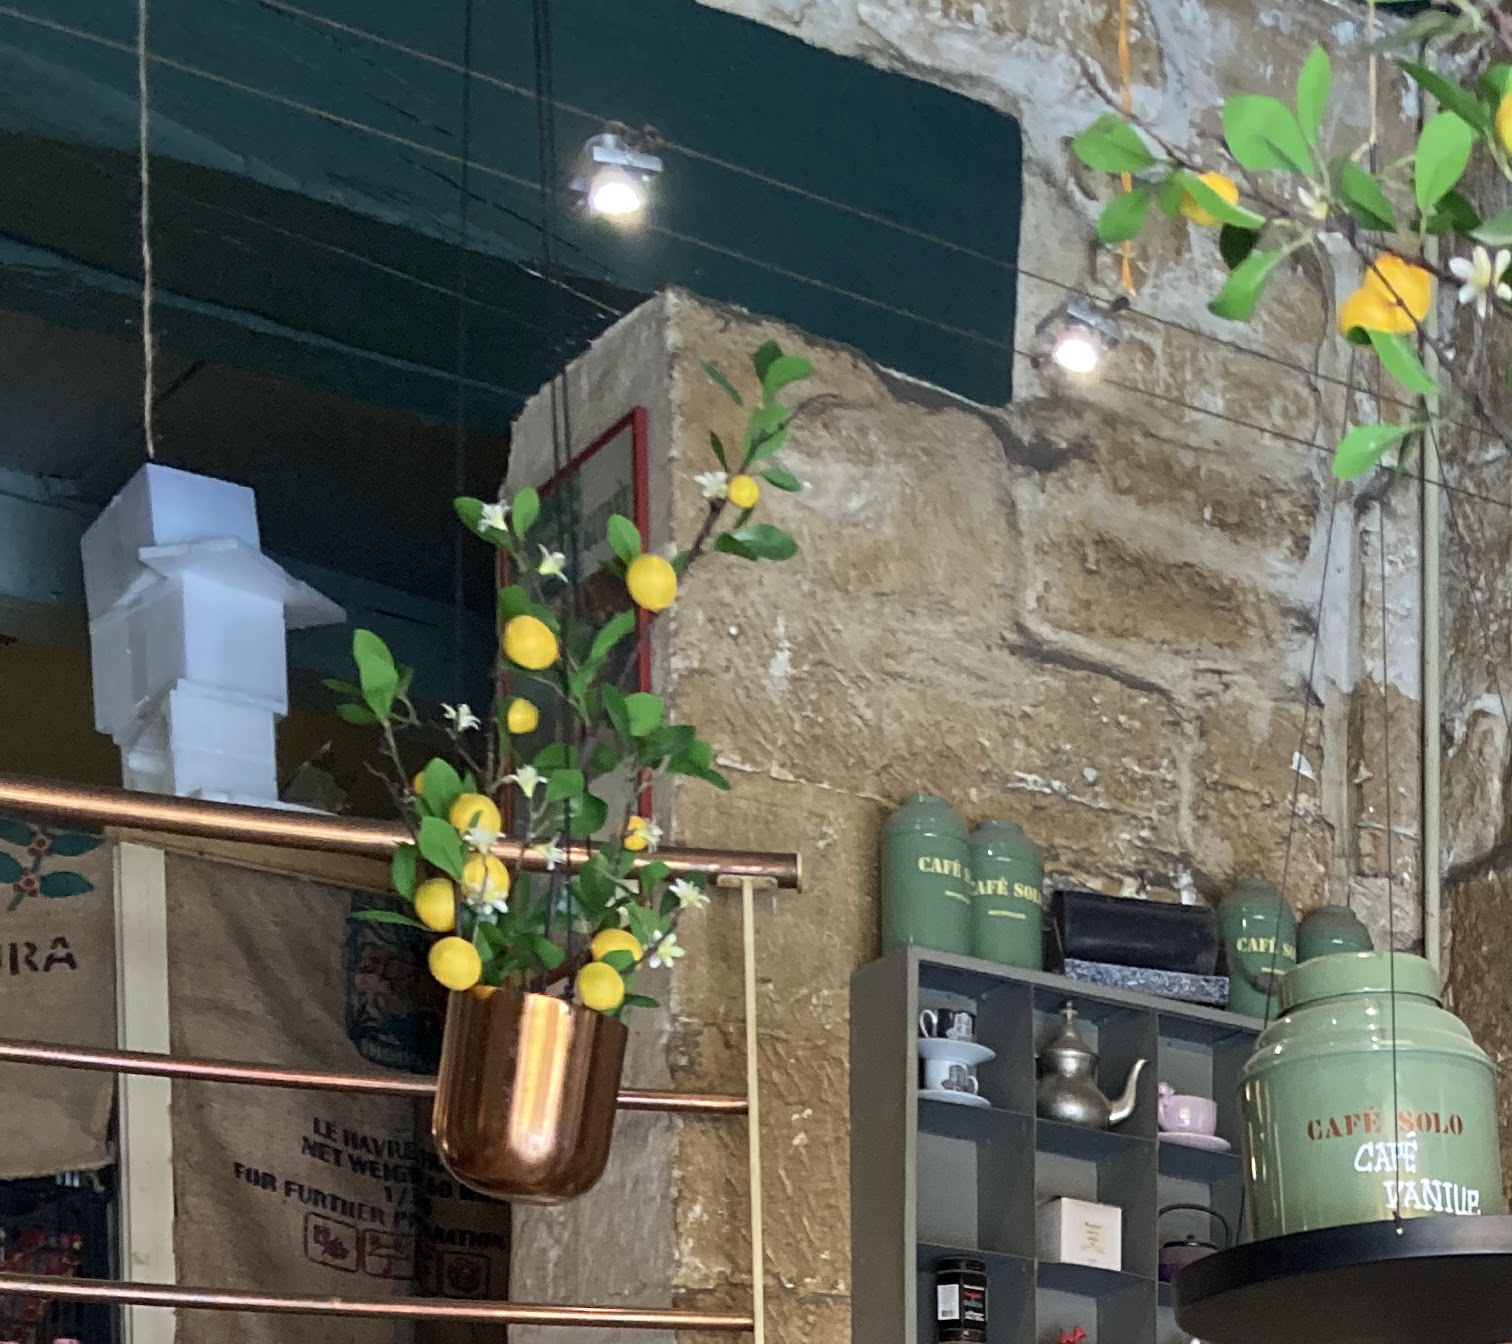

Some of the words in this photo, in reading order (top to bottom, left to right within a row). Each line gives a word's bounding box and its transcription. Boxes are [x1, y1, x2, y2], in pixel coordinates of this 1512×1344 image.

[971, 876, 1008, 896] AFÉ
[0, 936, 78, 976] RA
[1307, 1105, 1383, 1141] CAFÉ
[1397, 1110, 1464, 1136] SOLO
[1354, 1131, 1418, 1173] CAFÉ
